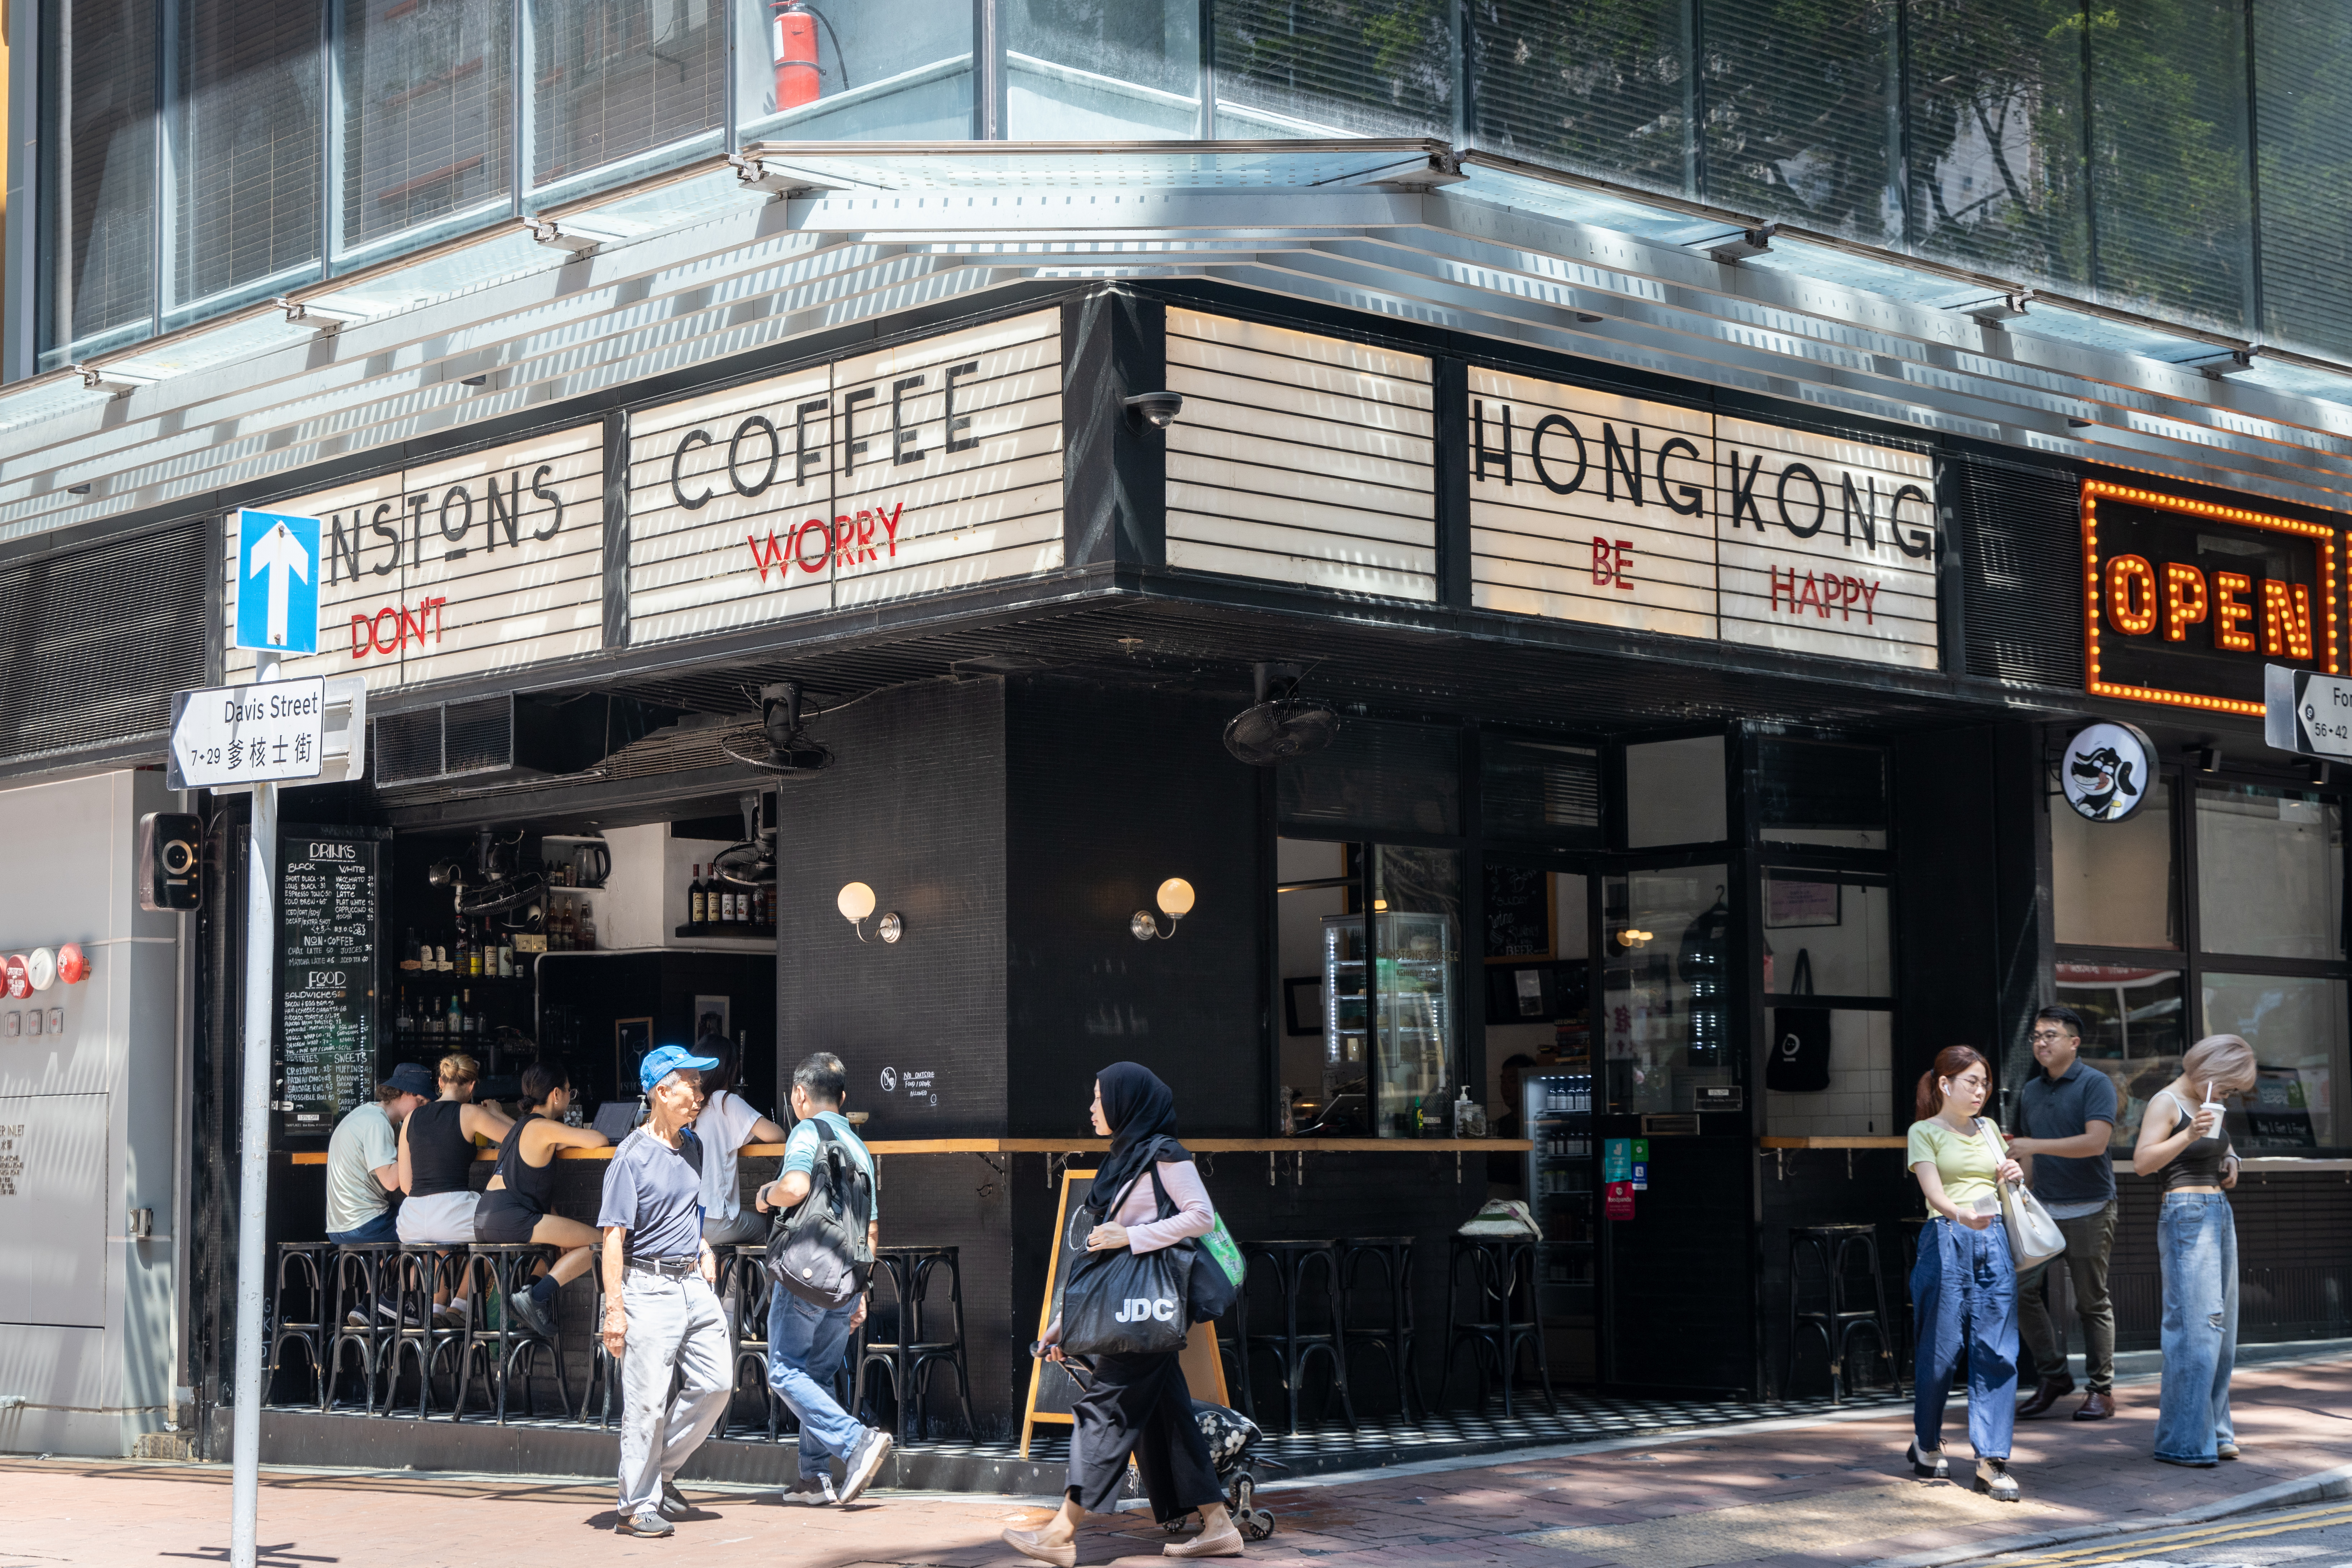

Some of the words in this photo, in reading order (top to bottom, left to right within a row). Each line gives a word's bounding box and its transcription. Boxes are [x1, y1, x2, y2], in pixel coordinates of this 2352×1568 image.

[671, 360, 979, 510] COFFEE
[1474, 399, 1703, 518] HONG
[1731, 450, 1932, 561] KONG
[331, 465, 563, 586] NSTONS
[747, 502, 903, 584] WORRY
[1593, 536, 1634, 590] BE
[1771, 565, 1881, 625] HAPPY
[2105, 554, 2313, 660] OPEN
[352, 596, 446, 659] DON'T
[225, 698, 264, 723] Davis
[270, 691, 318, 718] Street
[228, 733, 312, 770] 爹核士街
[310, 843, 355, 858] DRINKS
[288, 863, 315, 873] BLACK
[288, 946, 303, 955] CHAI
[340, 946, 362, 954] JUICES
[1381, 948, 1423, 960] WINSTONS
[1426, 951, 1458, 961] COFFEE
[1506, 945, 1533, 956] BEER
[289, 957, 310, 966] MATCHA
[7, 968, 23, 976] SPRINKLER
[309, 971, 346, 987] FOOD
[287, 1054, 319, 1063] PASTRIES
[334, 1052, 367, 1063] SWEETS
[287, 1084, 311, 1093] SAUSAGE
[8, 1124, 24, 1138] INLET
[1115, 1298, 1174, 1323] JDC
